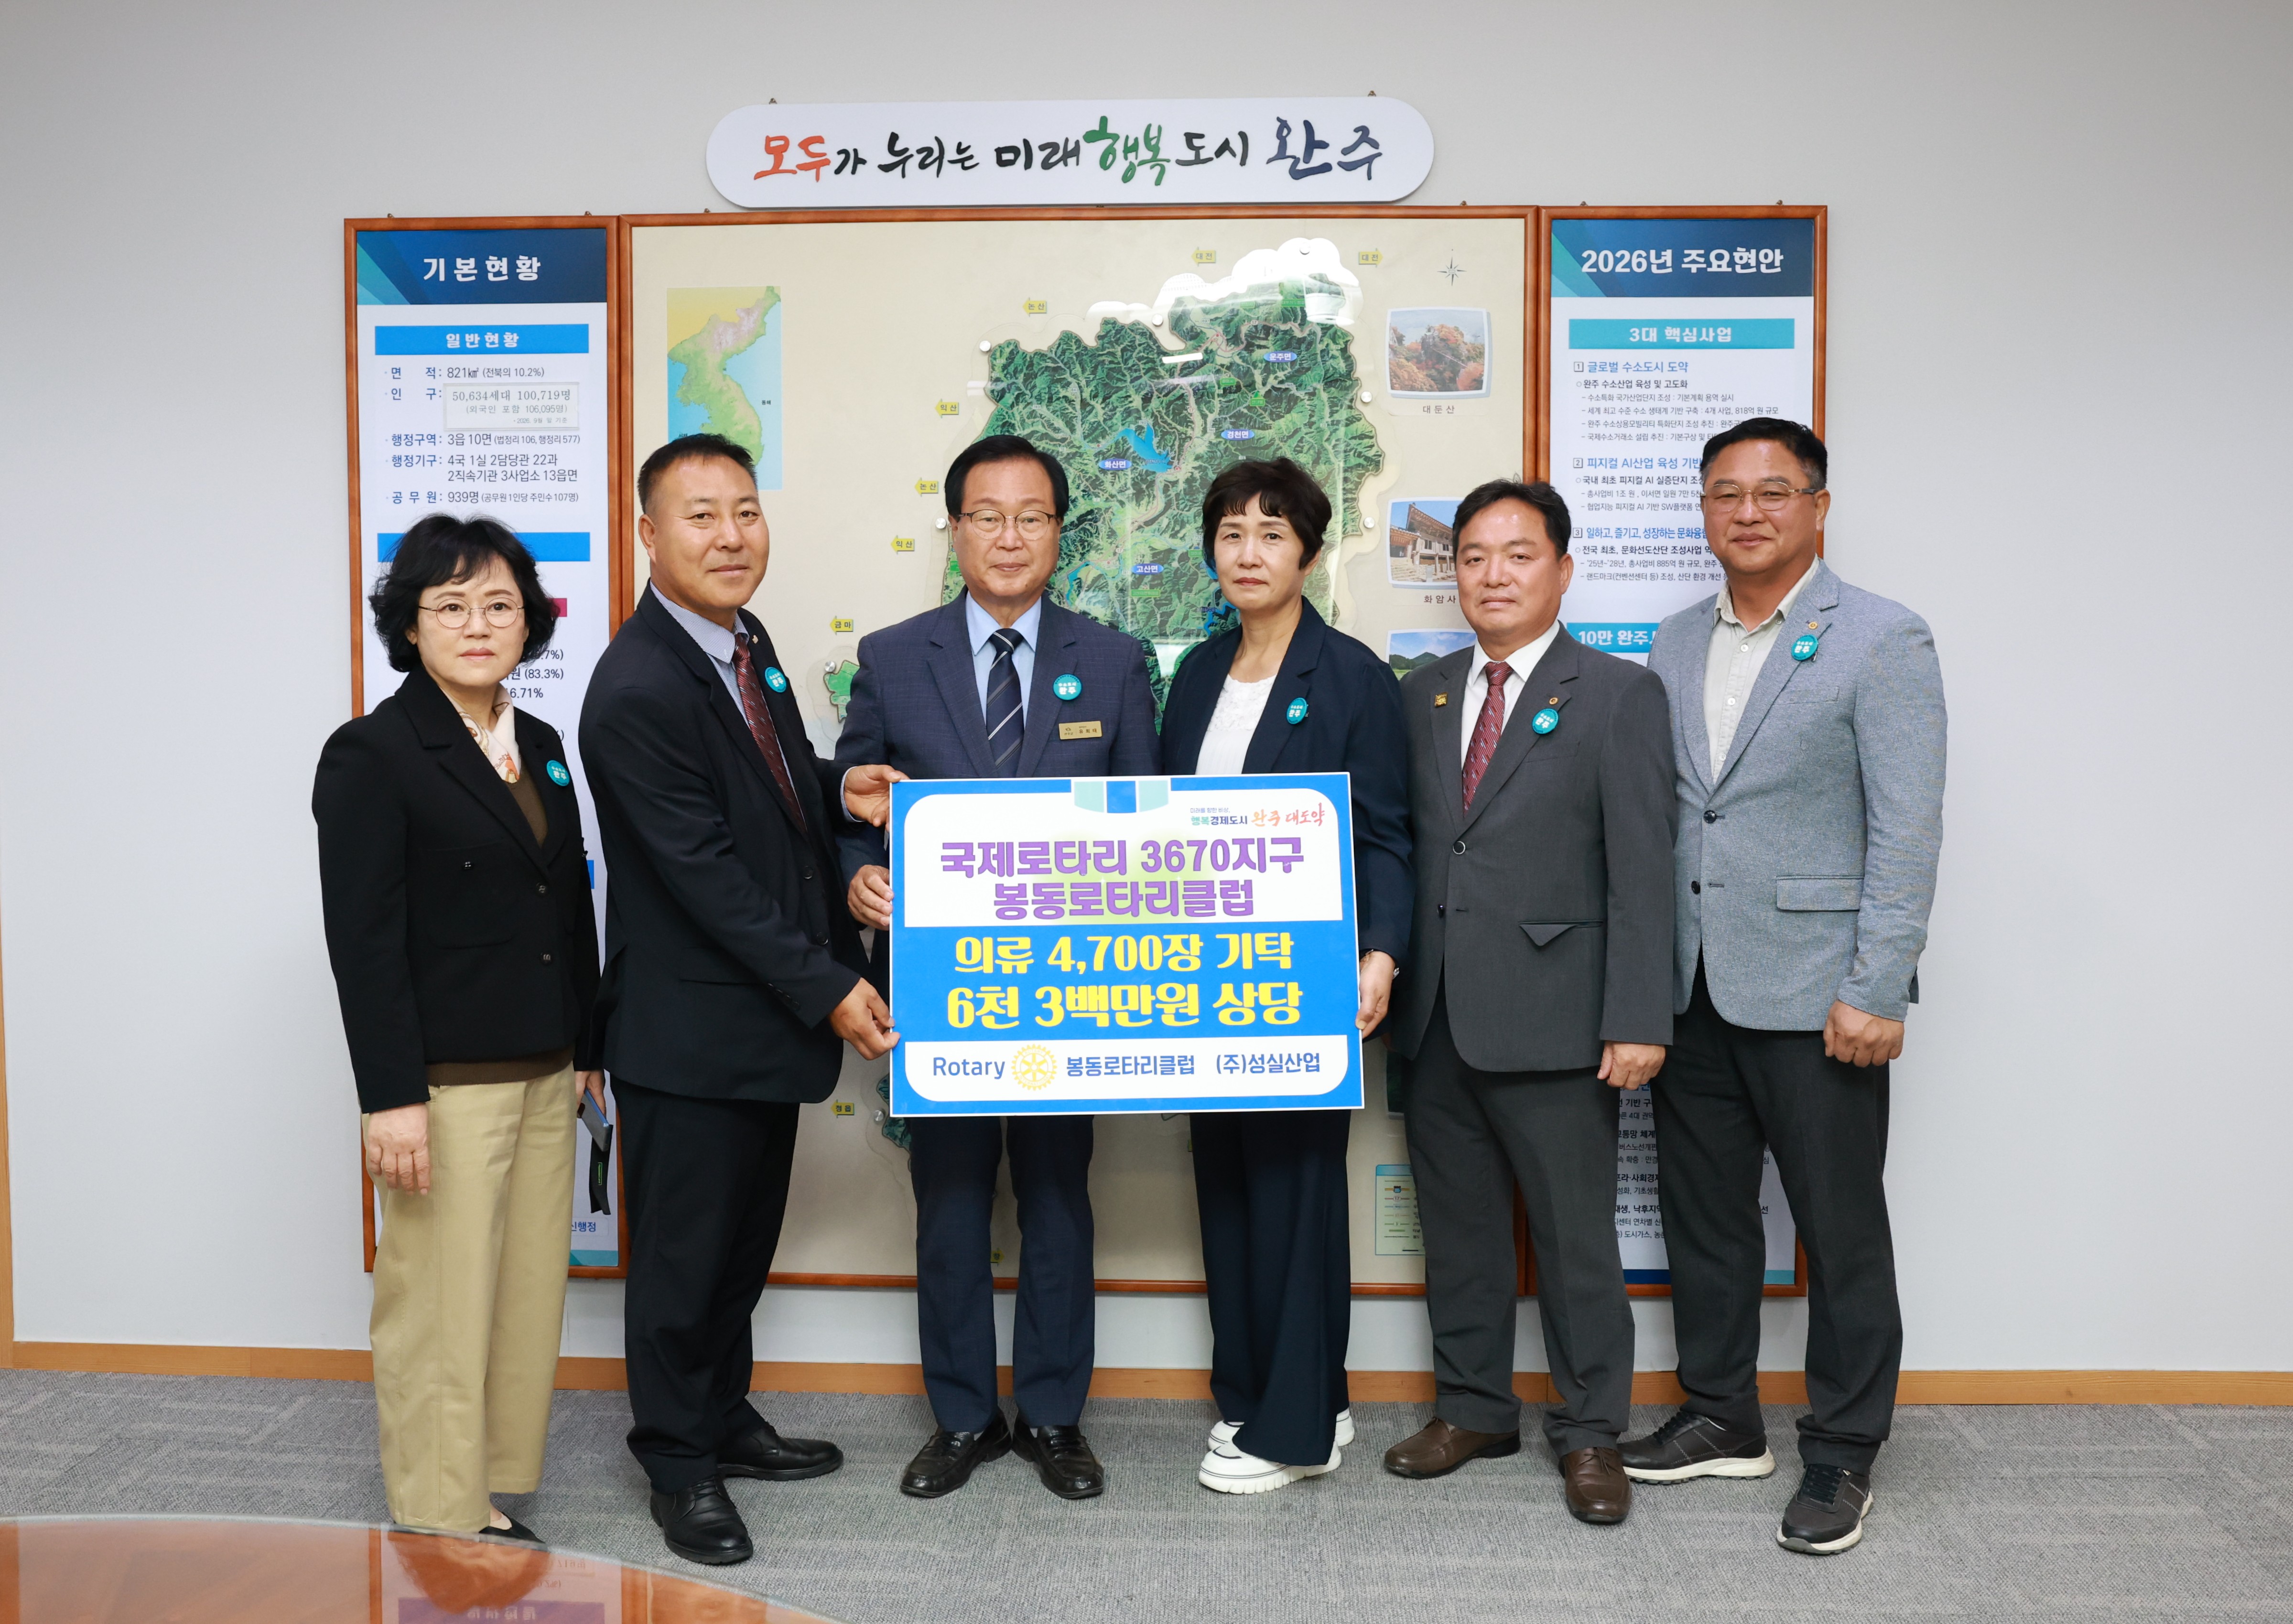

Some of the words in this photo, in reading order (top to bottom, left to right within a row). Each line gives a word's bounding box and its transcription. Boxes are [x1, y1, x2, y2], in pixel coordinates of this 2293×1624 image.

[754, 135, 867, 182] 모두가
[877, 131, 980, 179] 누리는
[1266, 116, 1384, 182] 완주
[1581, 249, 1672, 274] 2026년
[1682, 247, 1784, 273] 주요현안
[424, 255, 541, 281] 기본현황
[446, 332, 519, 348] 일반현황
[1629, 328, 1657, 342] 3대
[1665, 326, 1731, 342] 핵심사업
[483, 368, 510, 377] (전북의
[515, 367, 544, 377] 10.2%)
[1588, 362, 1618, 373] 글로벌
[1622, 362, 1663, 373] 수소도시
[1667, 362, 1688, 373] 도약
[1584, 380, 1599, 388] 완주
[1602, 380, 1632, 388] 수소산업
[1635, 380, 1650, 388] 육성
[1654, 380, 1661, 388] 및
[1665, 380, 1687, 388] 고도화
[453, 390, 509, 401] 50,634세대
[518, 389, 570, 401] 100,719명
[1706, 394, 1718, 402] 용역
[466, 405, 495, 414] (외국인
[526, 405, 567, 414] 106,095명)
[1423, 405, 1455, 414] 대둔산
[1603, 420, 1655, 428] 수소상용모빌리티
[448, 433, 465, 445] 3읍
[469, 433, 491, 445] 10면
[448, 455, 465, 466] 4국
[470, 454, 486, 466] 1실
[491, 454, 530, 466] 2담당관
[533, 454, 558, 466] 22과
[1588, 458, 1617, 469] 피지컬
[1622, 458, 1653, 469] AI산업
[1657, 458, 1677, 469] 육성
[1682, 458, 1701, 469] 기반
[448, 470, 498, 482] 2직속기관
[501, 470, 540, 482] 3사업소
[544, 470, 577, 482] 13읍면
[1583, 476, 1598, 484] 국내
[1601, 476, 1616, 484] 최초
[1620, 476, 1642, 484] 피지컬
[1656, 476, 1687, 485] 실증단지
[448, 491, 478, 503] 939명
[1588, 490, 1613, 498] 총사업비
[1587, 527, 1612, 538] 일하고,
[1615, 527, 1641, 538] 즐기고,
[1643, 527, 1676, 538] 성장하는
[1583, 546, 1598, 554] 전국
[1601, 546, 1618, 554] 최초,
[1622, 546, 1668, 554] 문화선도산단
[1671, 546, 1701, 555] 조성사업
[1704, 559, 1718, 567] 완주
[1693, 573, 1706, 581] 환경
[1424, 595, 1456, 604] 화암사
[1578, 631, 1613, 645] 10만
[525, 668, 563, 679] (83.3%)
[1191, 816, 1247, 826] 행복경제도시
[1251, 809, 1281, 827] 완주
[1285, 802, 1325, 827] 대도약
[941, 840, 1127, 879] 국제로타리
[1140, 838, 1304, 873] 3670지구
[994, 879, 1255, 921] 봉동로타리클럽
[955, 936, 1034, 974] 의류
[1047, 932, 1203, 974] 4,700장
[1216, 931, 1294, 970] 기탁
[947, 986, 1019, 1029] 6천
[1036, 983, 1200, 1028] 3백만원
[1212, 981, 1302, 1025] 상당
[933, 1057, 1005, 1079] Rotary
[1066, 1055, 1195, 1077] 봉동로타리클럽
[1215, 1053, 1321, 1076] (주)성실산업
